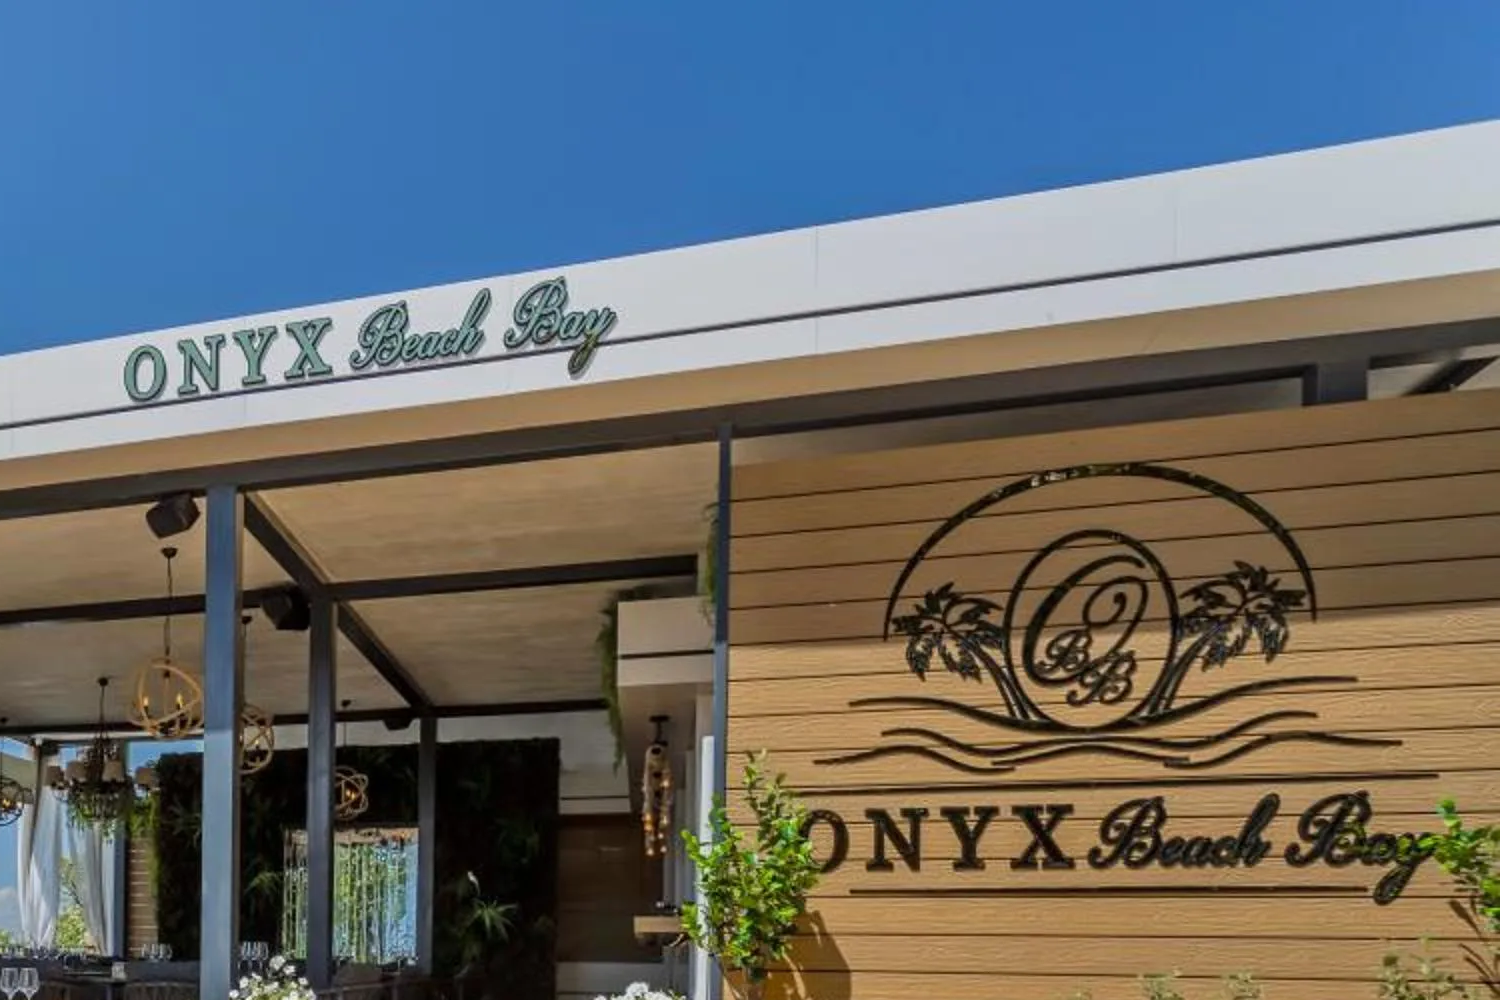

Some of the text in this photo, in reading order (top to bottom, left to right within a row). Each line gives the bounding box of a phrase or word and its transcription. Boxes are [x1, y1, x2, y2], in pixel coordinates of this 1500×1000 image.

[123, 275, 616, 401] ONYX Beach Bay
[798, 789, 1438, 906] ONYX Beach Bay
